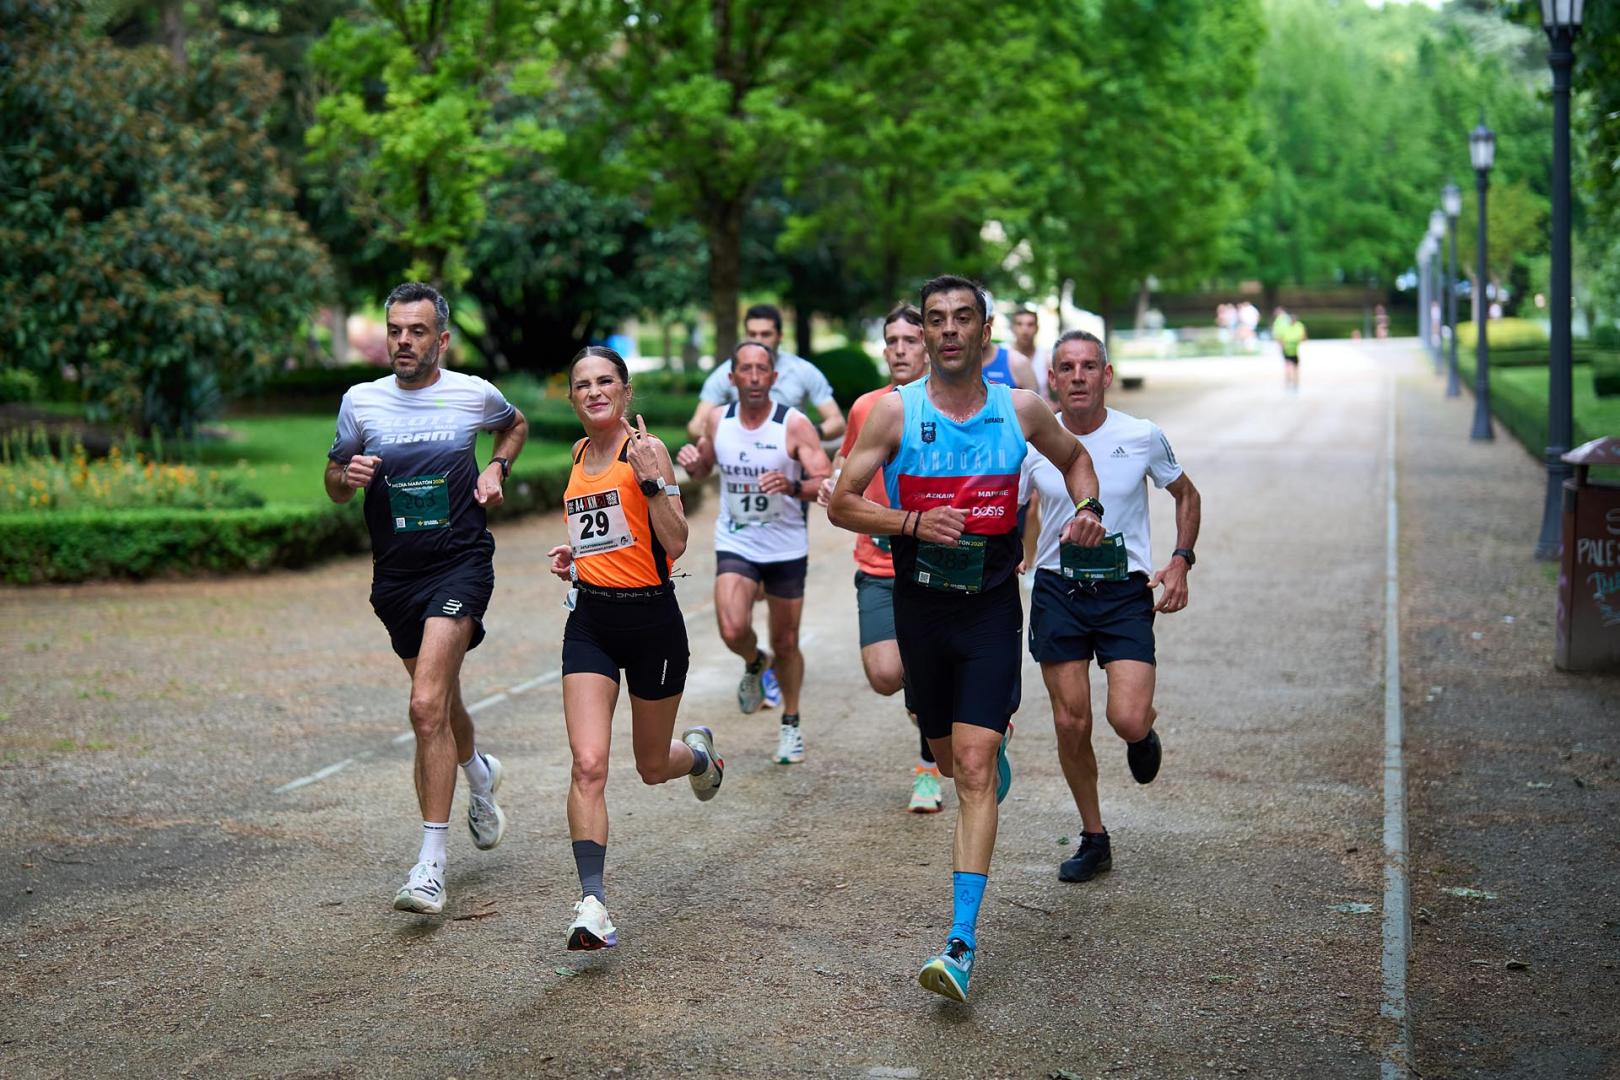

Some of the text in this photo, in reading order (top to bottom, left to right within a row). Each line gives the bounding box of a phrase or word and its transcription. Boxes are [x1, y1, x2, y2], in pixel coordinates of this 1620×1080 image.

[380, 431, 457, 445] SRAM
[740, 495, 769, 512] 19
[579, 510, 609, 540] 29
